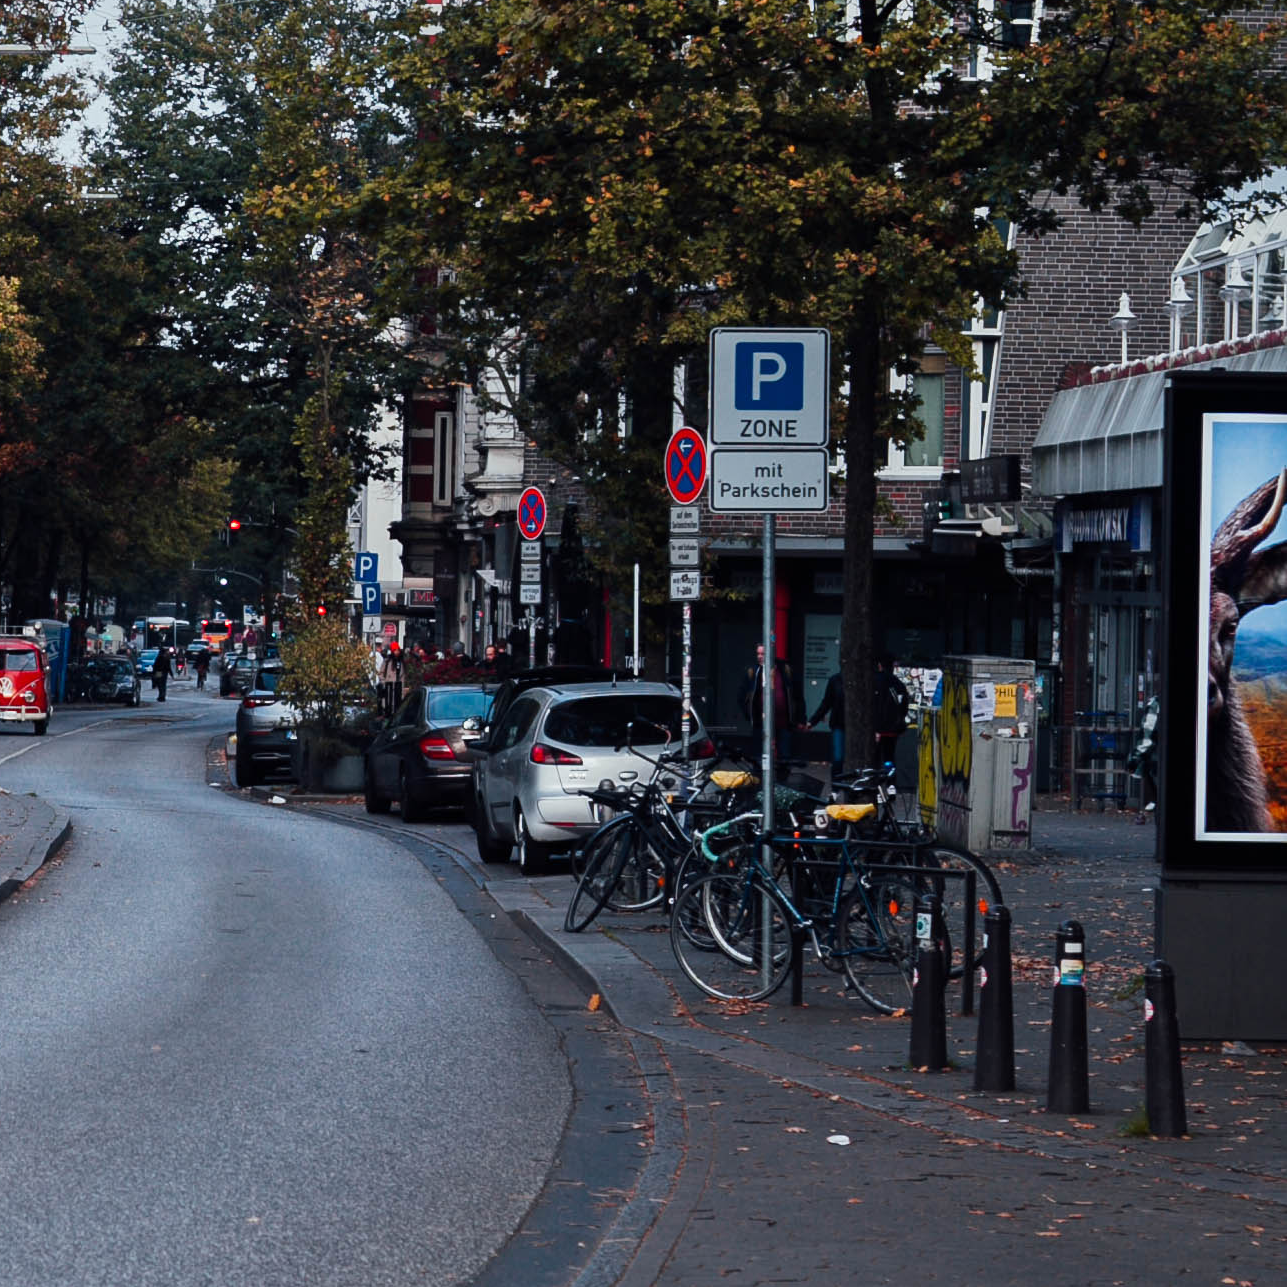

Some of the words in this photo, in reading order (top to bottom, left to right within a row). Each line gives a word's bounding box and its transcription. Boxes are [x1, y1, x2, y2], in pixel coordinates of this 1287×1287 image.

[752, 352, 787, 401] P
[740, 419, 797, 438] ZONE
[755, 463, 783, 478] mit
[720, 483, 818, 498] Parkschein
[359, 556, 373, 578] P
[365, 587, 377, 611] P
